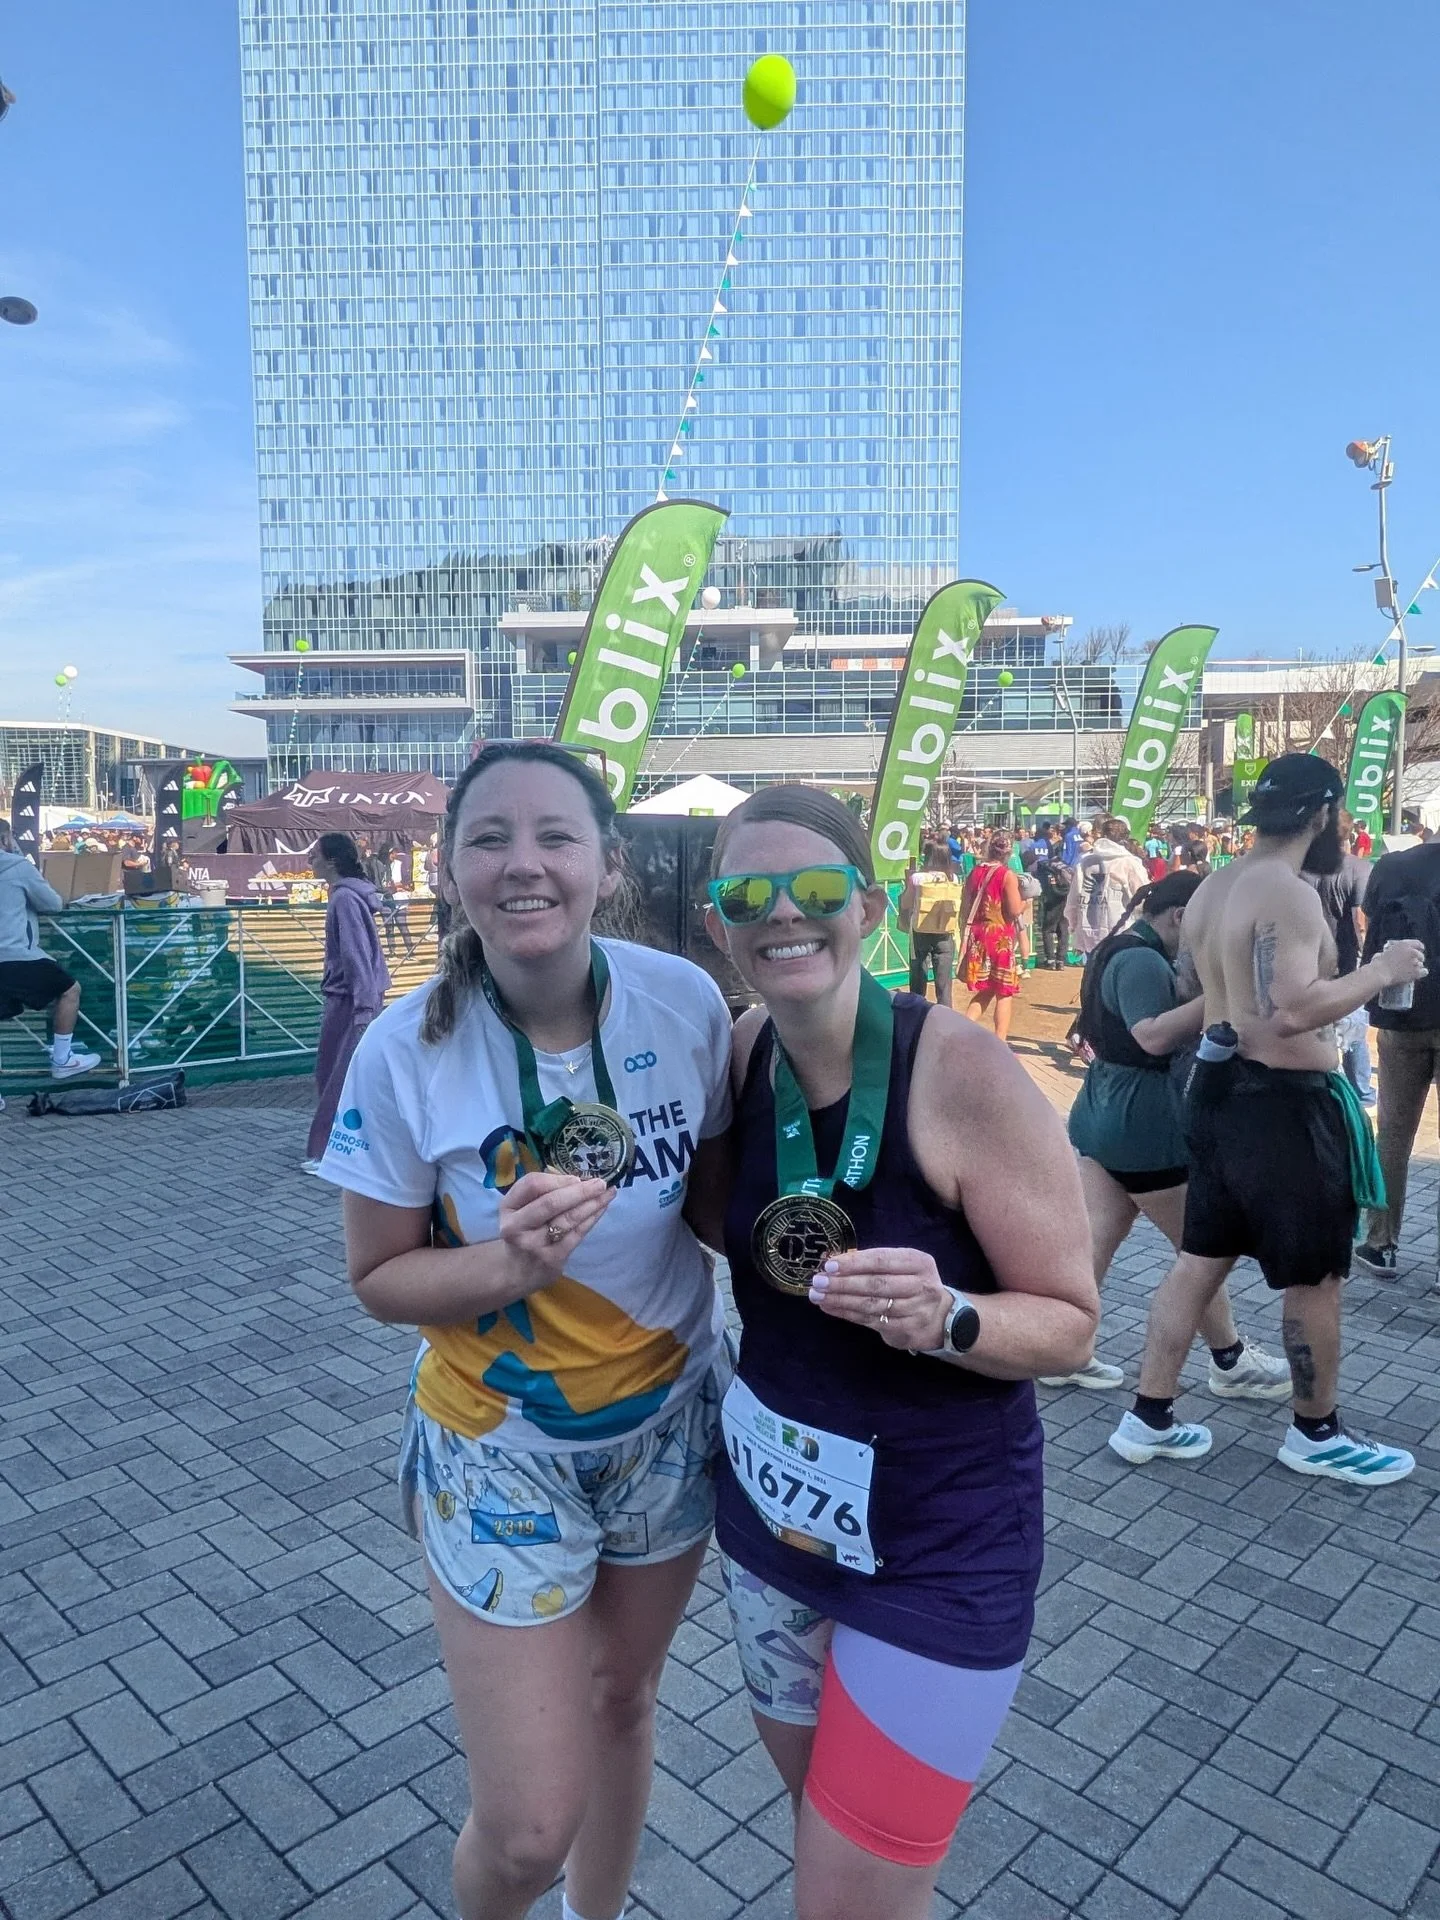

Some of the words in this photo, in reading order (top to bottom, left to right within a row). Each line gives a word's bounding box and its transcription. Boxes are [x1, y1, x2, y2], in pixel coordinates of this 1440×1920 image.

[577, 562, 690, 801] ublix
[1353, 715, 1393, 824] ublix
[188, 867, 210, 880] NTA
[331, 1129, 370, 1151] IBROSIS
[628, 1100, 687, 1136] THE
[328, 1139, 353, 1156] TION
[617, 1130, 697, 1189] AM
[843, 1135, 871, 1188] ATHON
[731, 1435, 862, 1537] J16776
[494, 1519, 535, 1536] 2319
